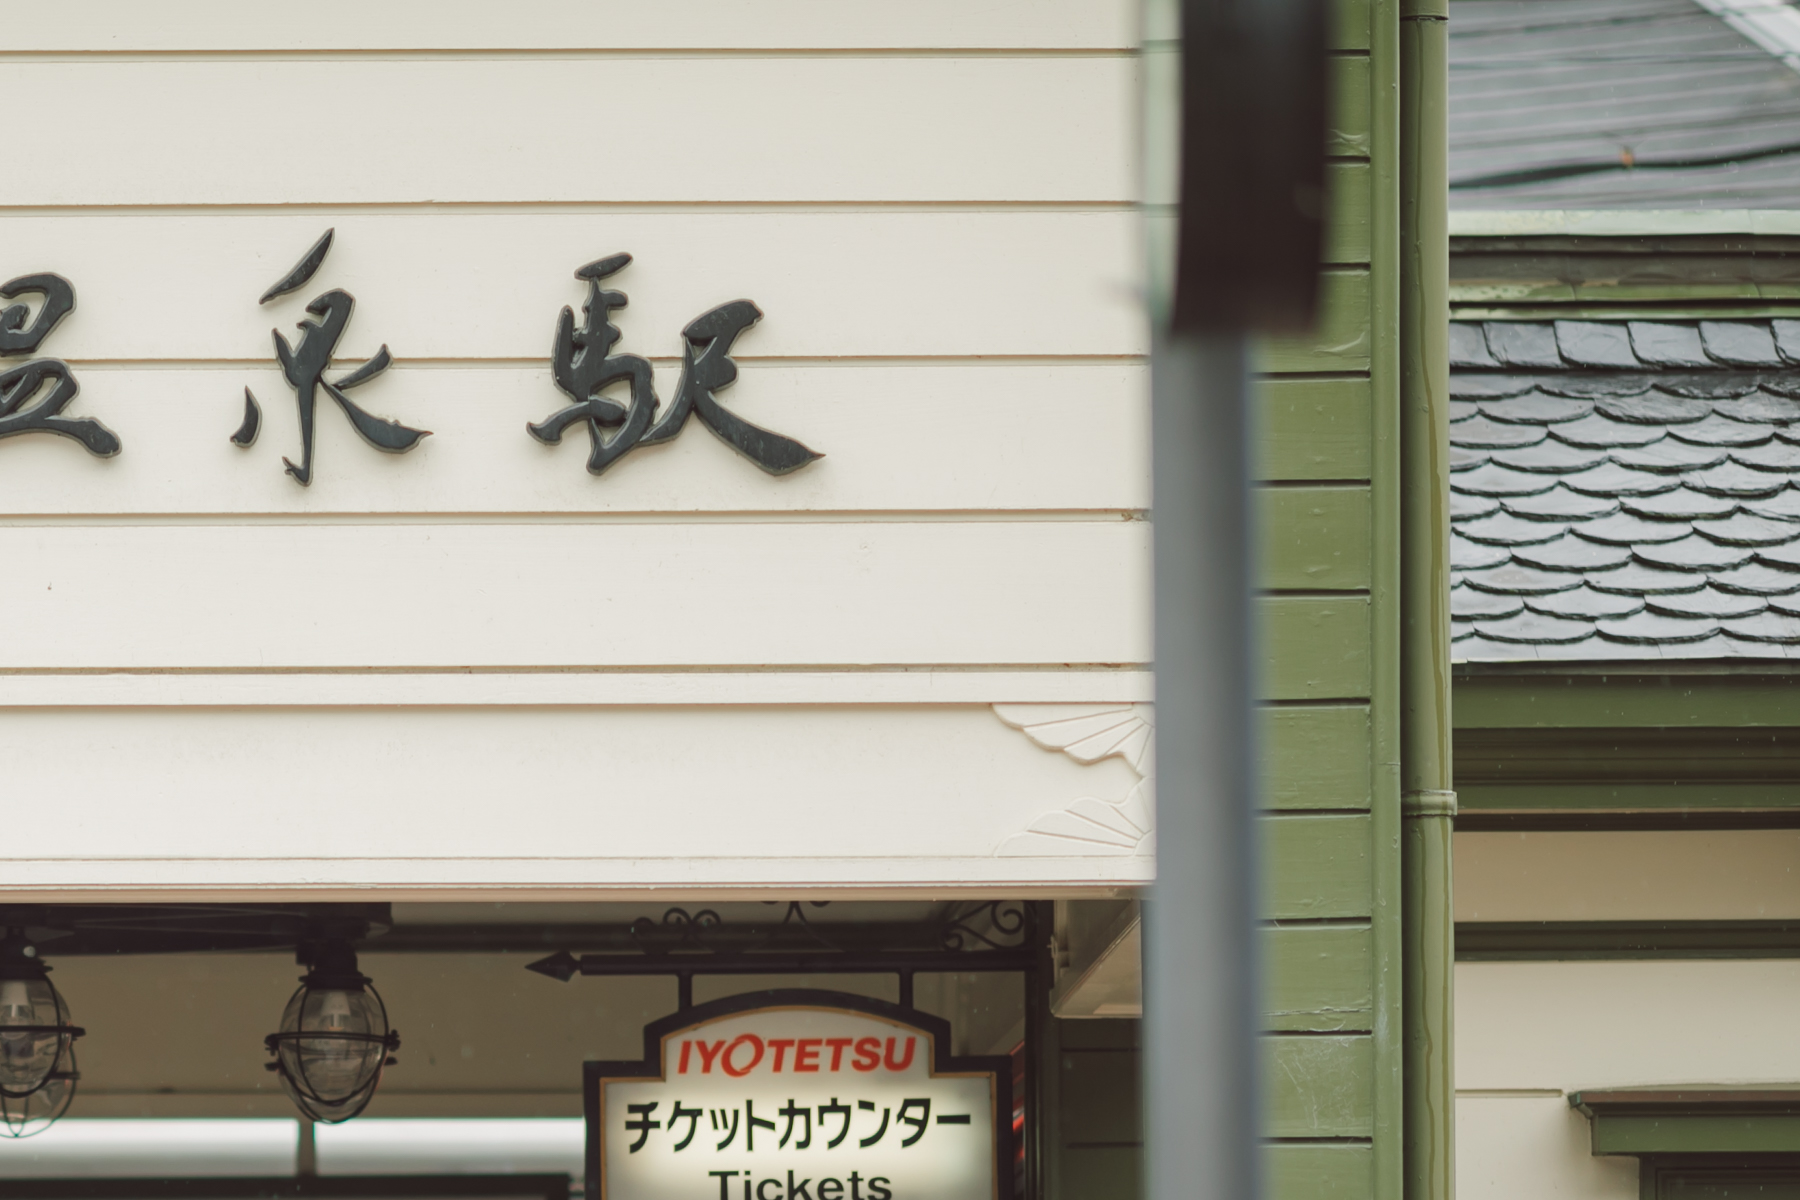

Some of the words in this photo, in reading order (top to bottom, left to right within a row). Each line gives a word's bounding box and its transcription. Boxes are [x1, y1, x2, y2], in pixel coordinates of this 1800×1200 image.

[677, 1034, 917, 1077] IYOTETSU
[624, 1097, 972, 1154] チケットカウンター
